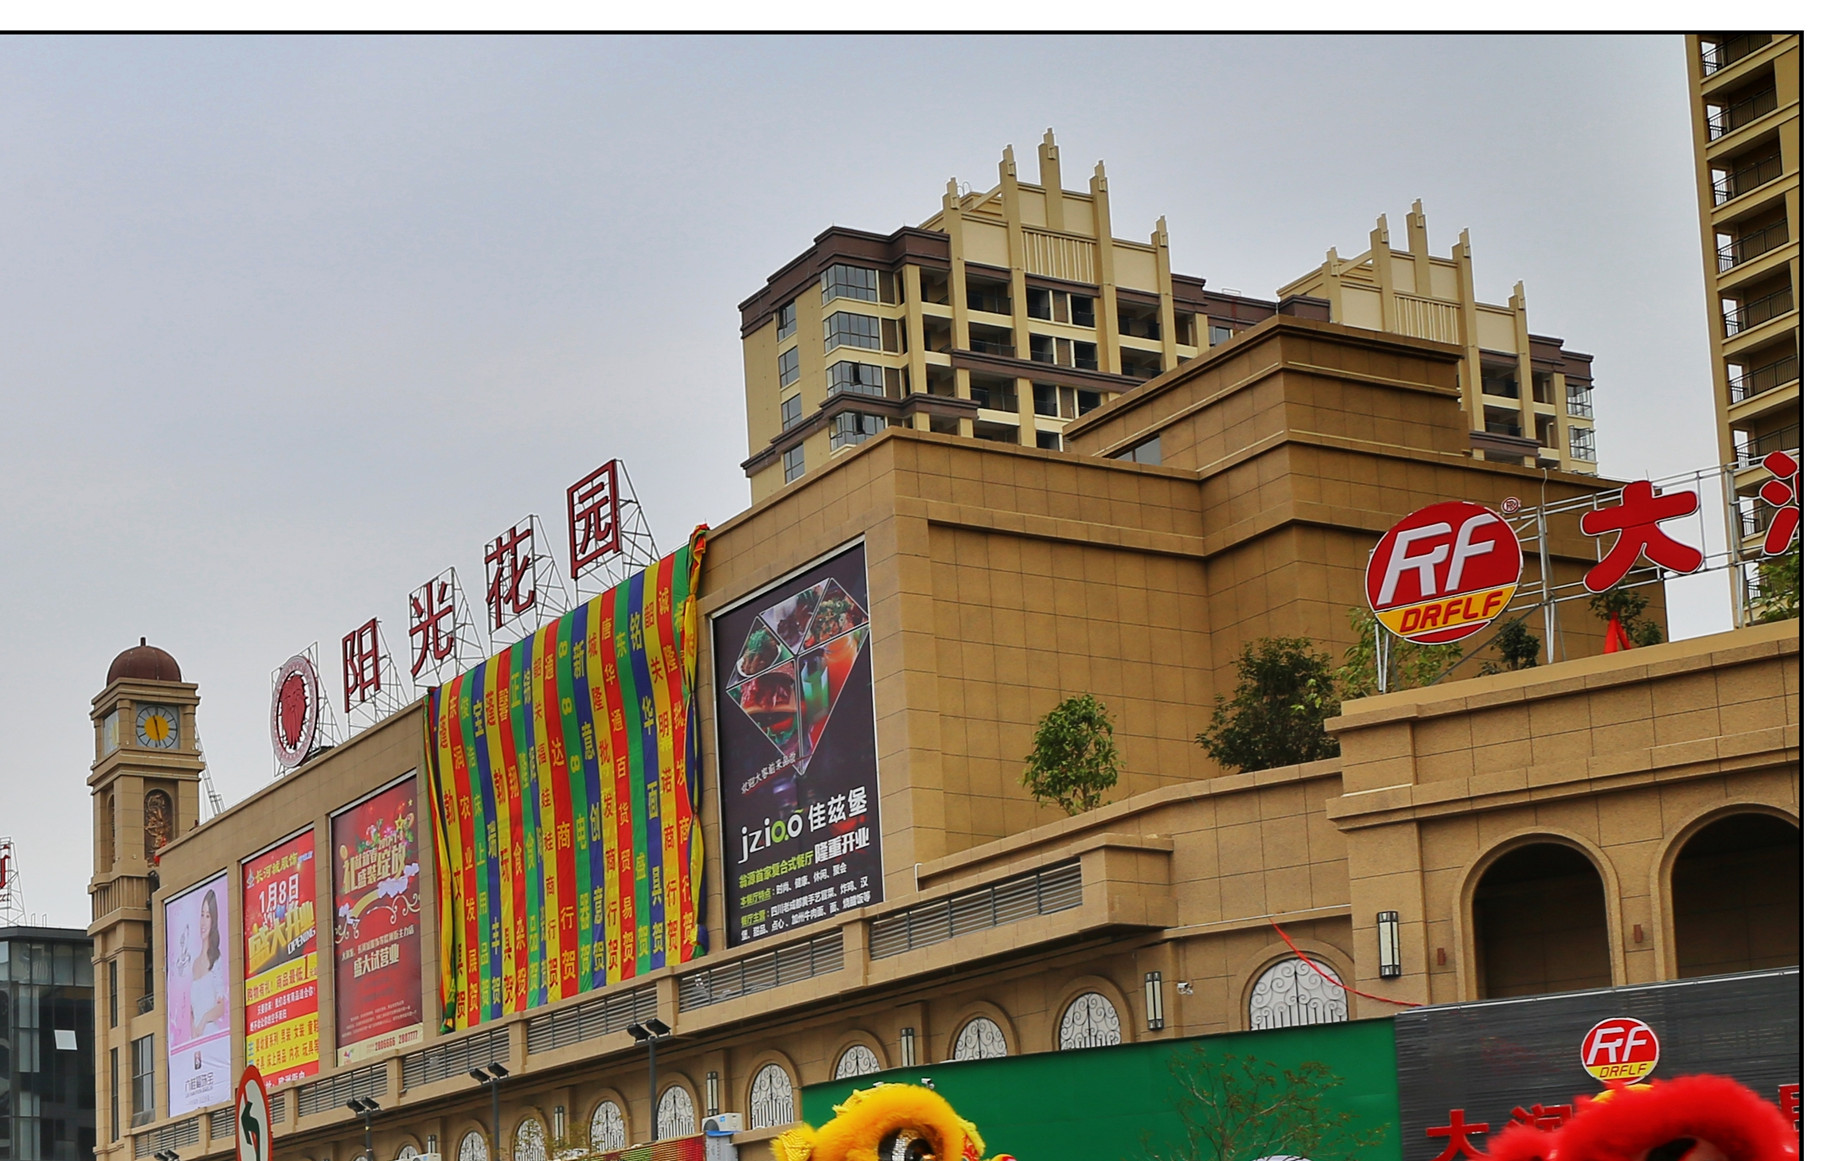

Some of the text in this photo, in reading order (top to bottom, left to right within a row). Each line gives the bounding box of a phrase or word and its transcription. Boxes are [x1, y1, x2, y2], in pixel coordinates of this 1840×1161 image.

[1376, 512, 1501, 607] RF
[341, 458, 621, 713] 阳光花园
[1398, 590, 1503, 634] DRFLF
[815, 827, 870, 864] 隆重开业
[259, 873, 299, 914] 1月8日
[248, 901, 316, 975] 盛大开业
[287, 927, 317, 955] OPENING
[353, 943, 400, 978] 盛大试营业
[1586, 1025, 1650, 1064] RF
[1598, 1062, 1648, 1079] DRFLF
